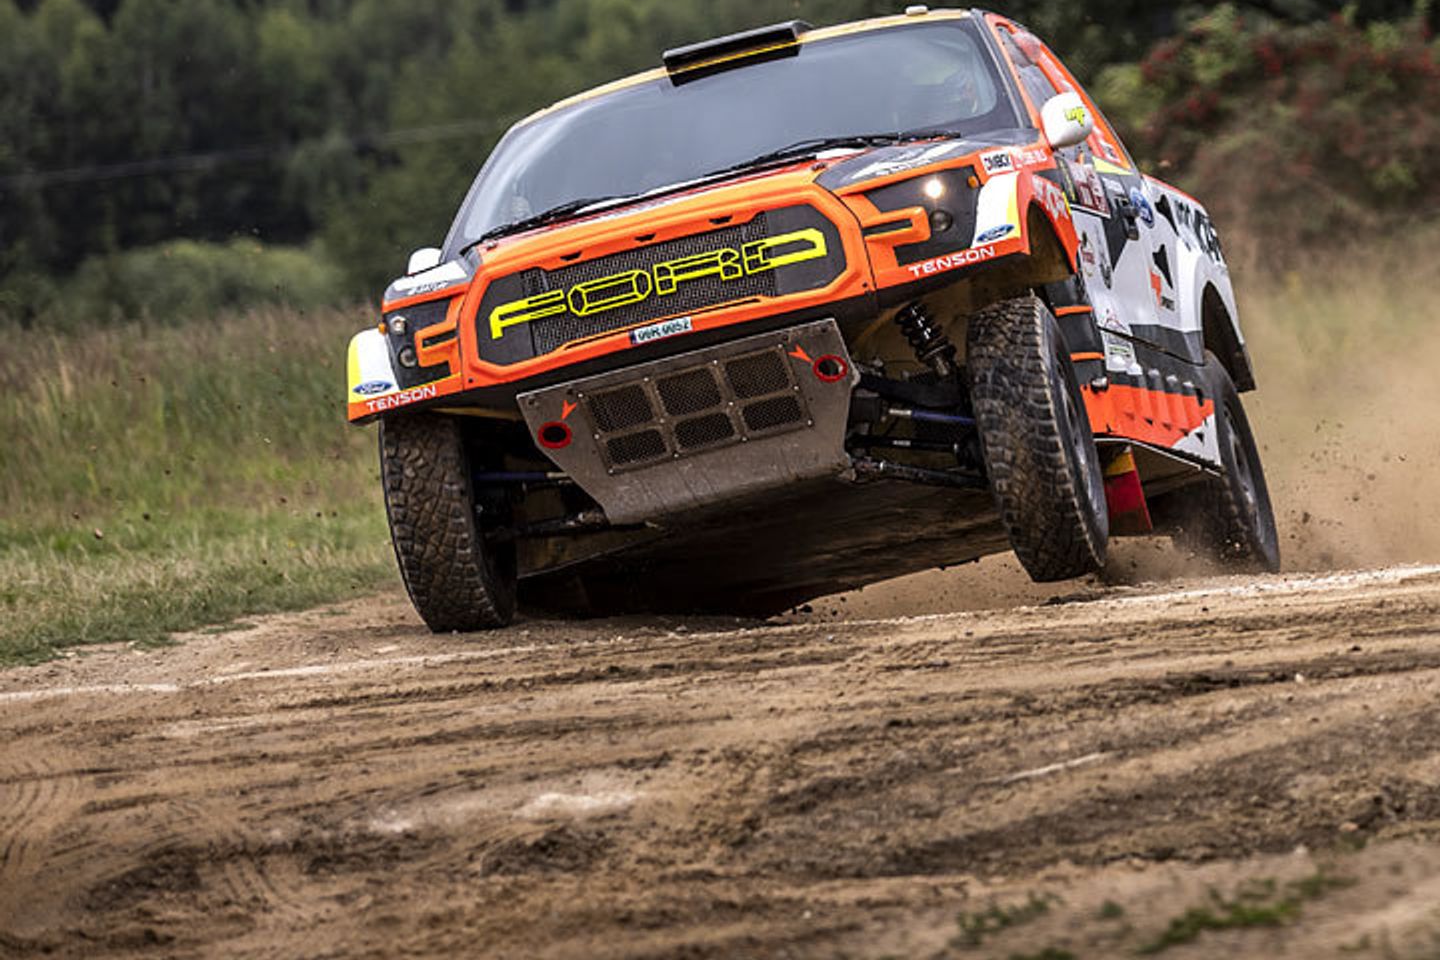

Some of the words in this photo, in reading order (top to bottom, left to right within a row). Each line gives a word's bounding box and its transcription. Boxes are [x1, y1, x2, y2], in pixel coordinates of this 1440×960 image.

[908, 245, 996, 278] TENSON
[489, 228, 827, 339] FORD
[366, 384, 437, 413] TENSON
